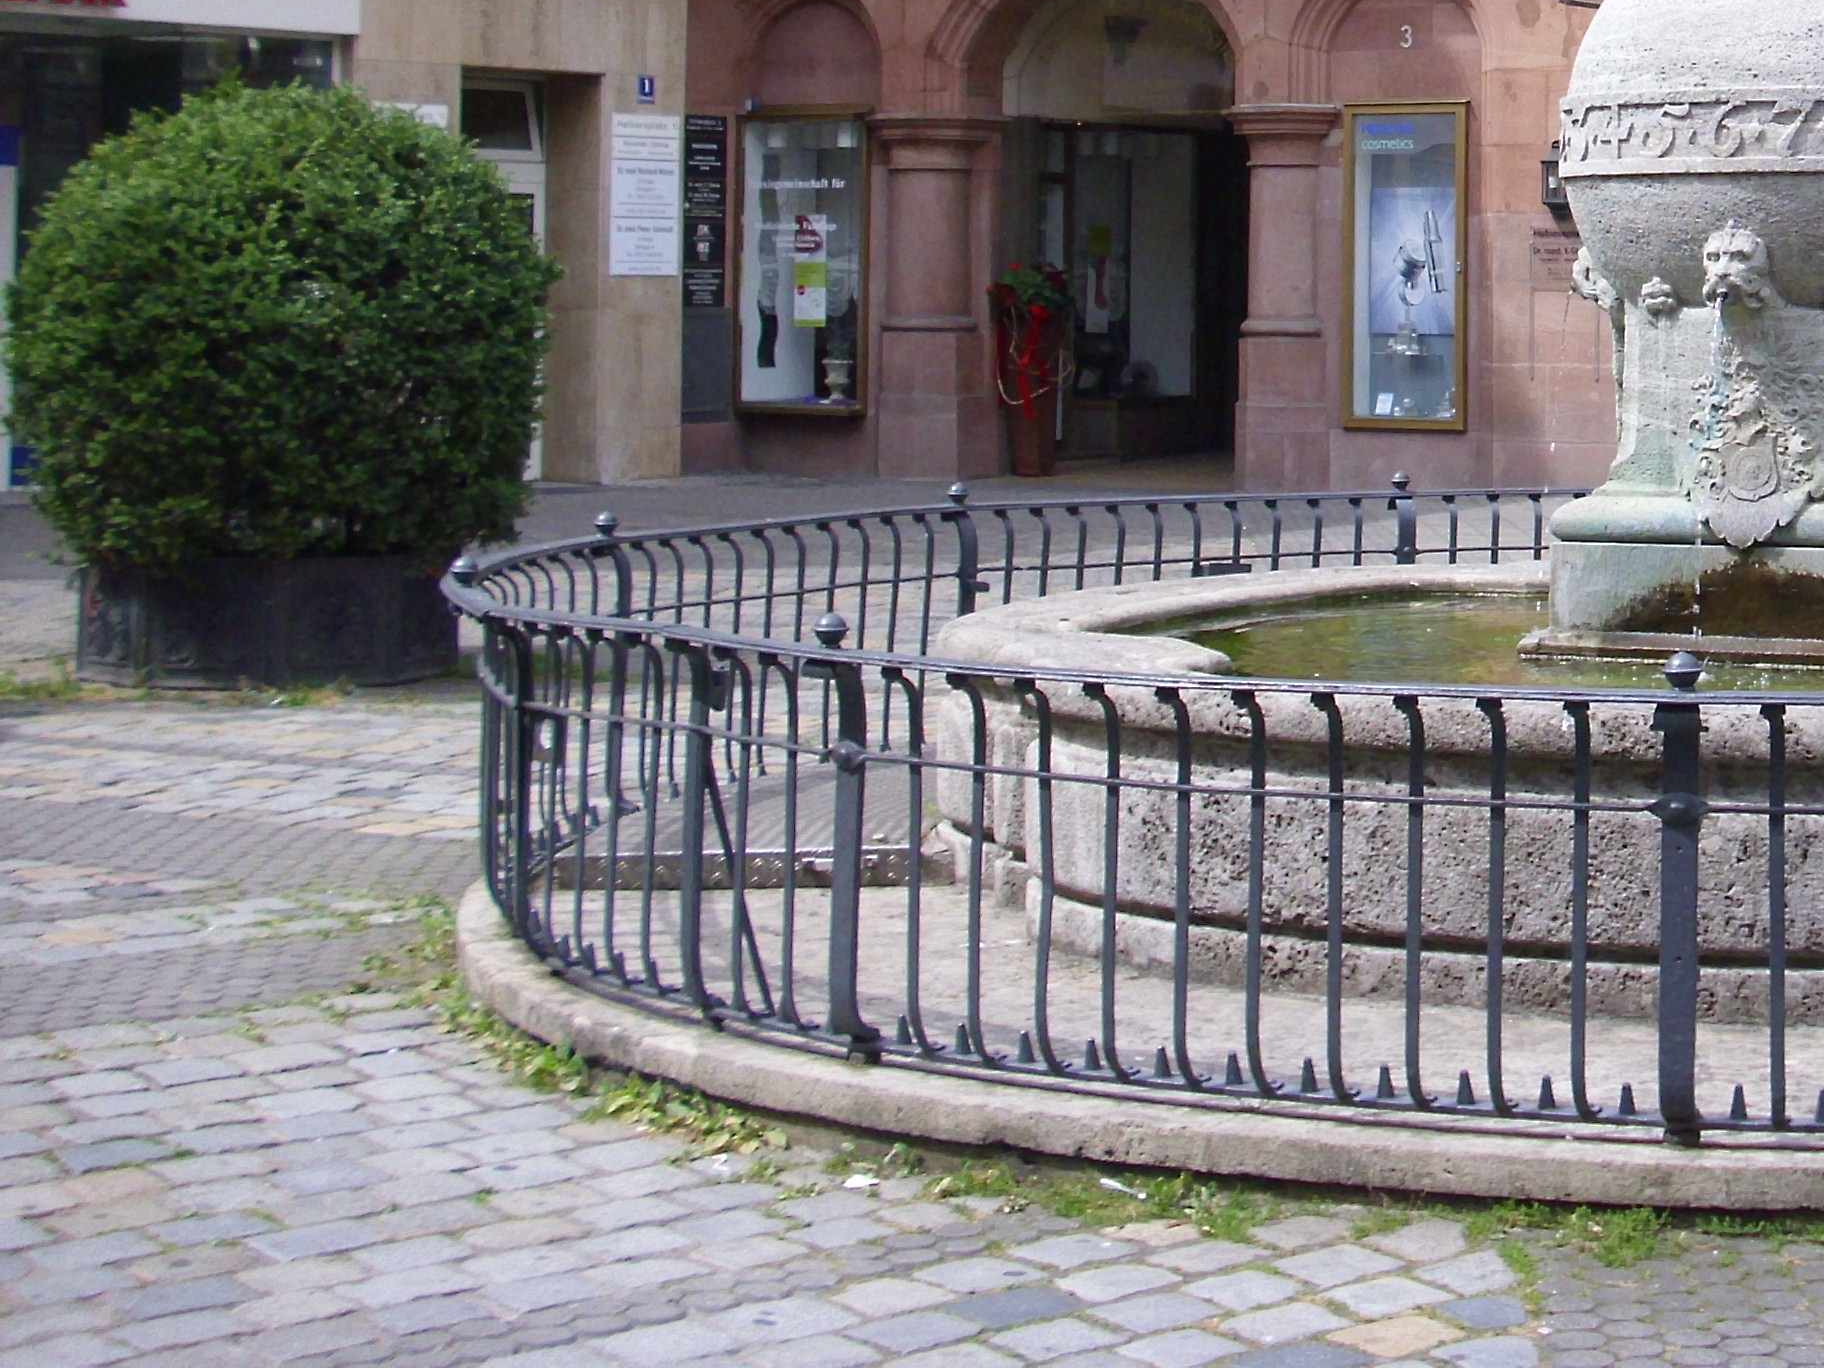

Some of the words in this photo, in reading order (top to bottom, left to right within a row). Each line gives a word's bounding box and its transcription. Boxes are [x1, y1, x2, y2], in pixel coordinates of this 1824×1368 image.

[1400, 24, 1412, 48] 3
[1711, 100, 1746, 158] 6
[1361, 138, 1414, 150] cosmetics
